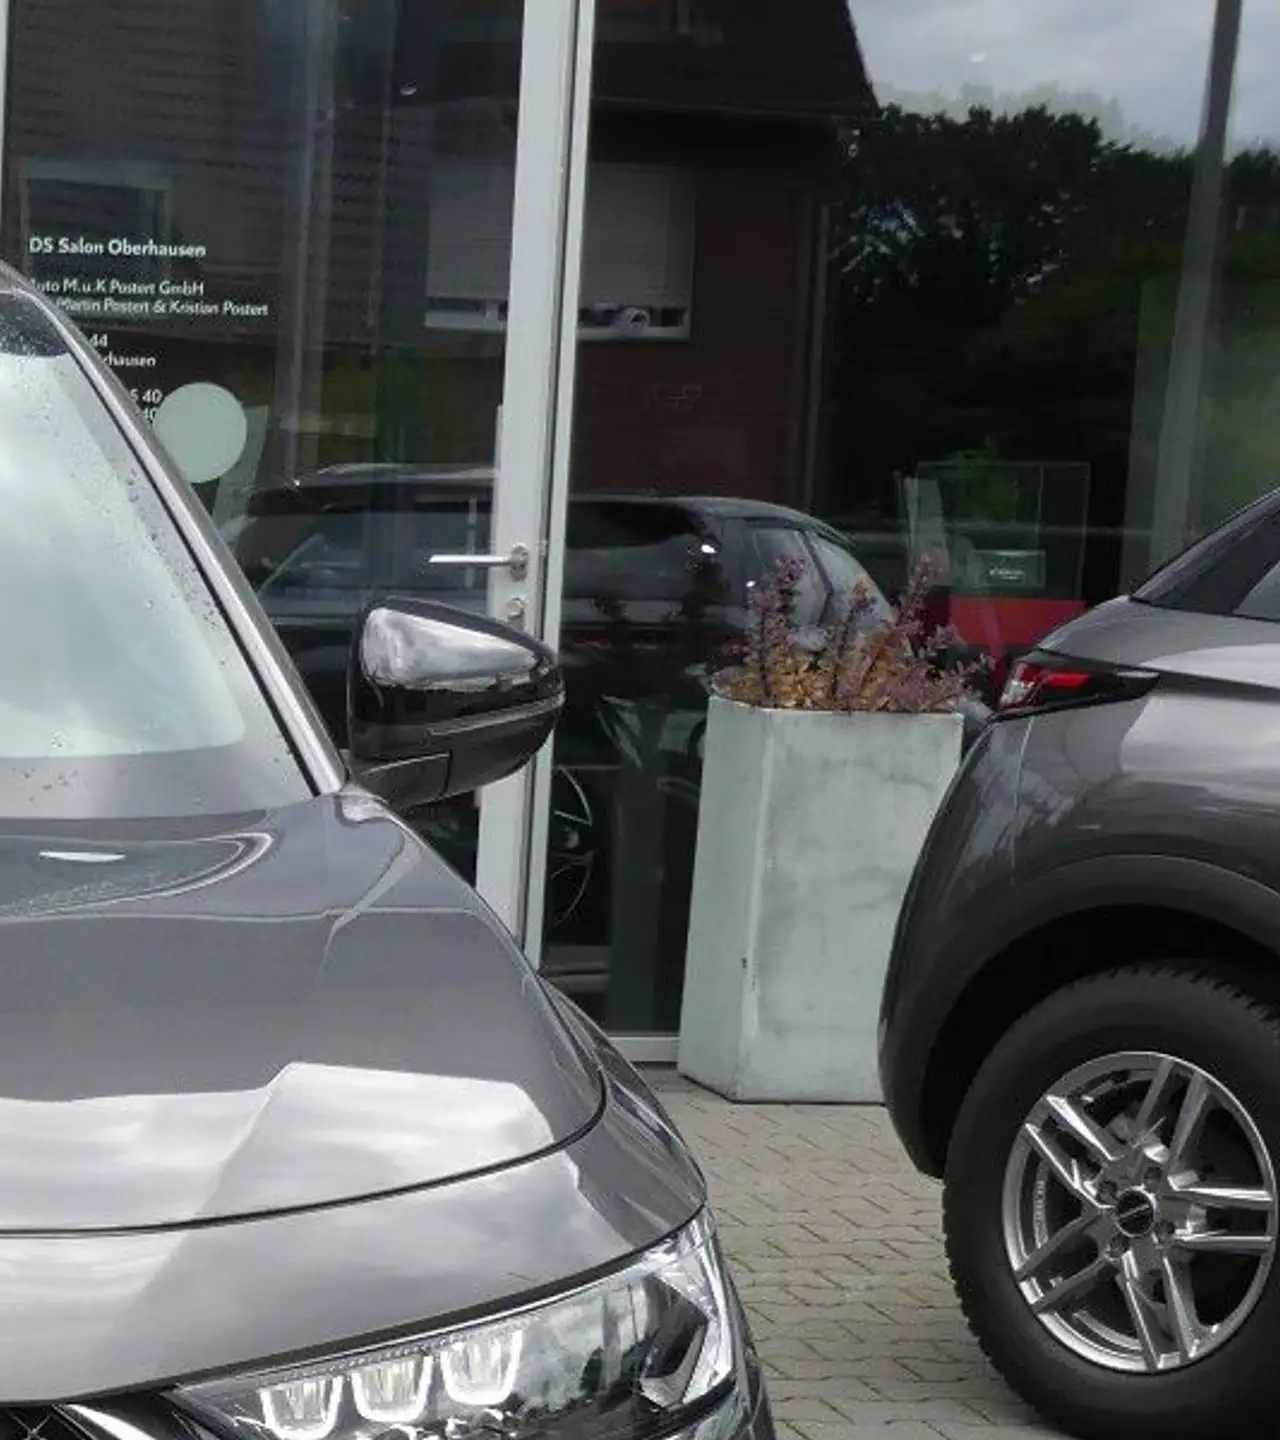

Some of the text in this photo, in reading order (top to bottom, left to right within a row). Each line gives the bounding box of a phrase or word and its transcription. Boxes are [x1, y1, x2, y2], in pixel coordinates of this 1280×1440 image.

[29, 237, 207, 258] DS Salon Oberhausen
[109, 279, 156, 296] Postert
[159, 280, 204, 296] GmbH
[103, 298, 149, 314] Postert
[152, 300, 166, 314] &
[168, 300, 219, 315] Kristian
[222, 301, 269, 316] Postert
